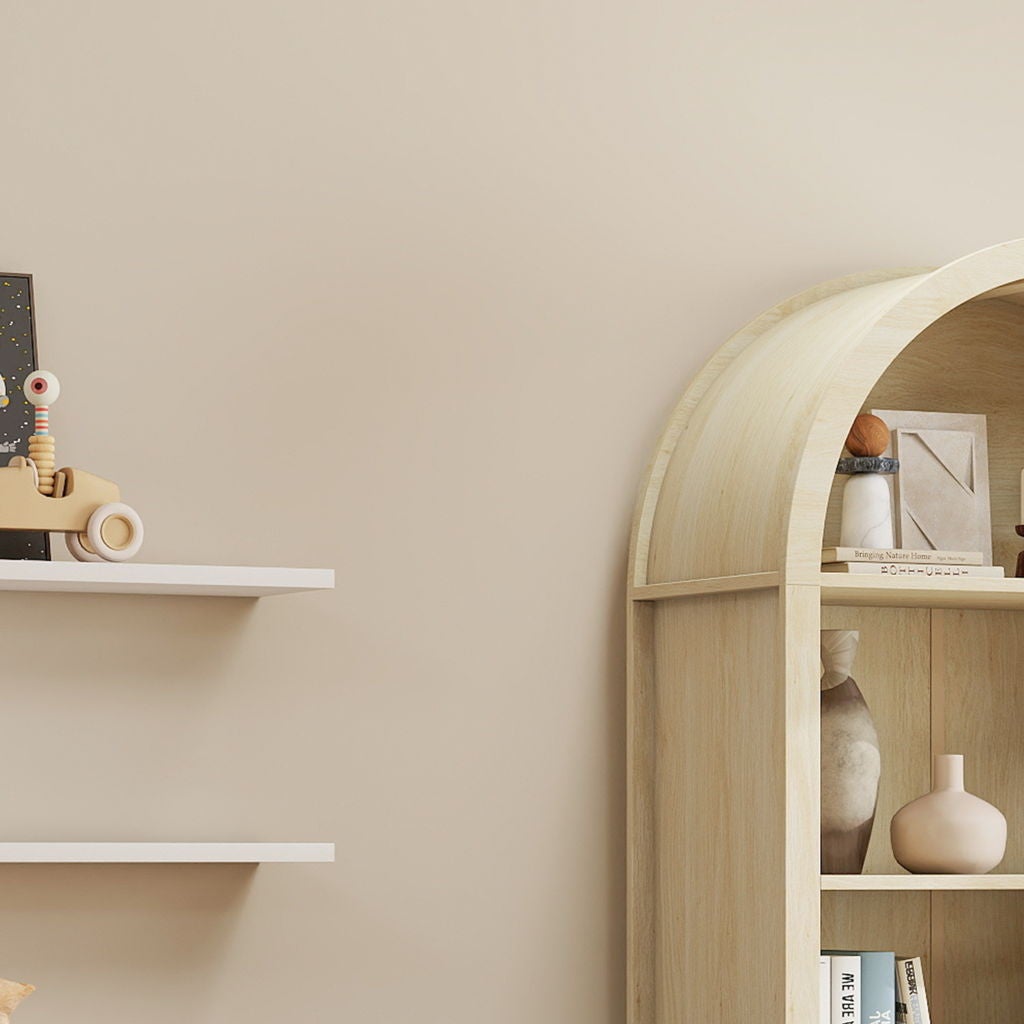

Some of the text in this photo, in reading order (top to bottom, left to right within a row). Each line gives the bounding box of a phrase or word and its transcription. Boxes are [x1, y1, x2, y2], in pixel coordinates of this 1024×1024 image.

[854, 550, 885, 560] Bringing
[886, 551, 909, 560] Nature
[911, 552, 932, 560] Home
